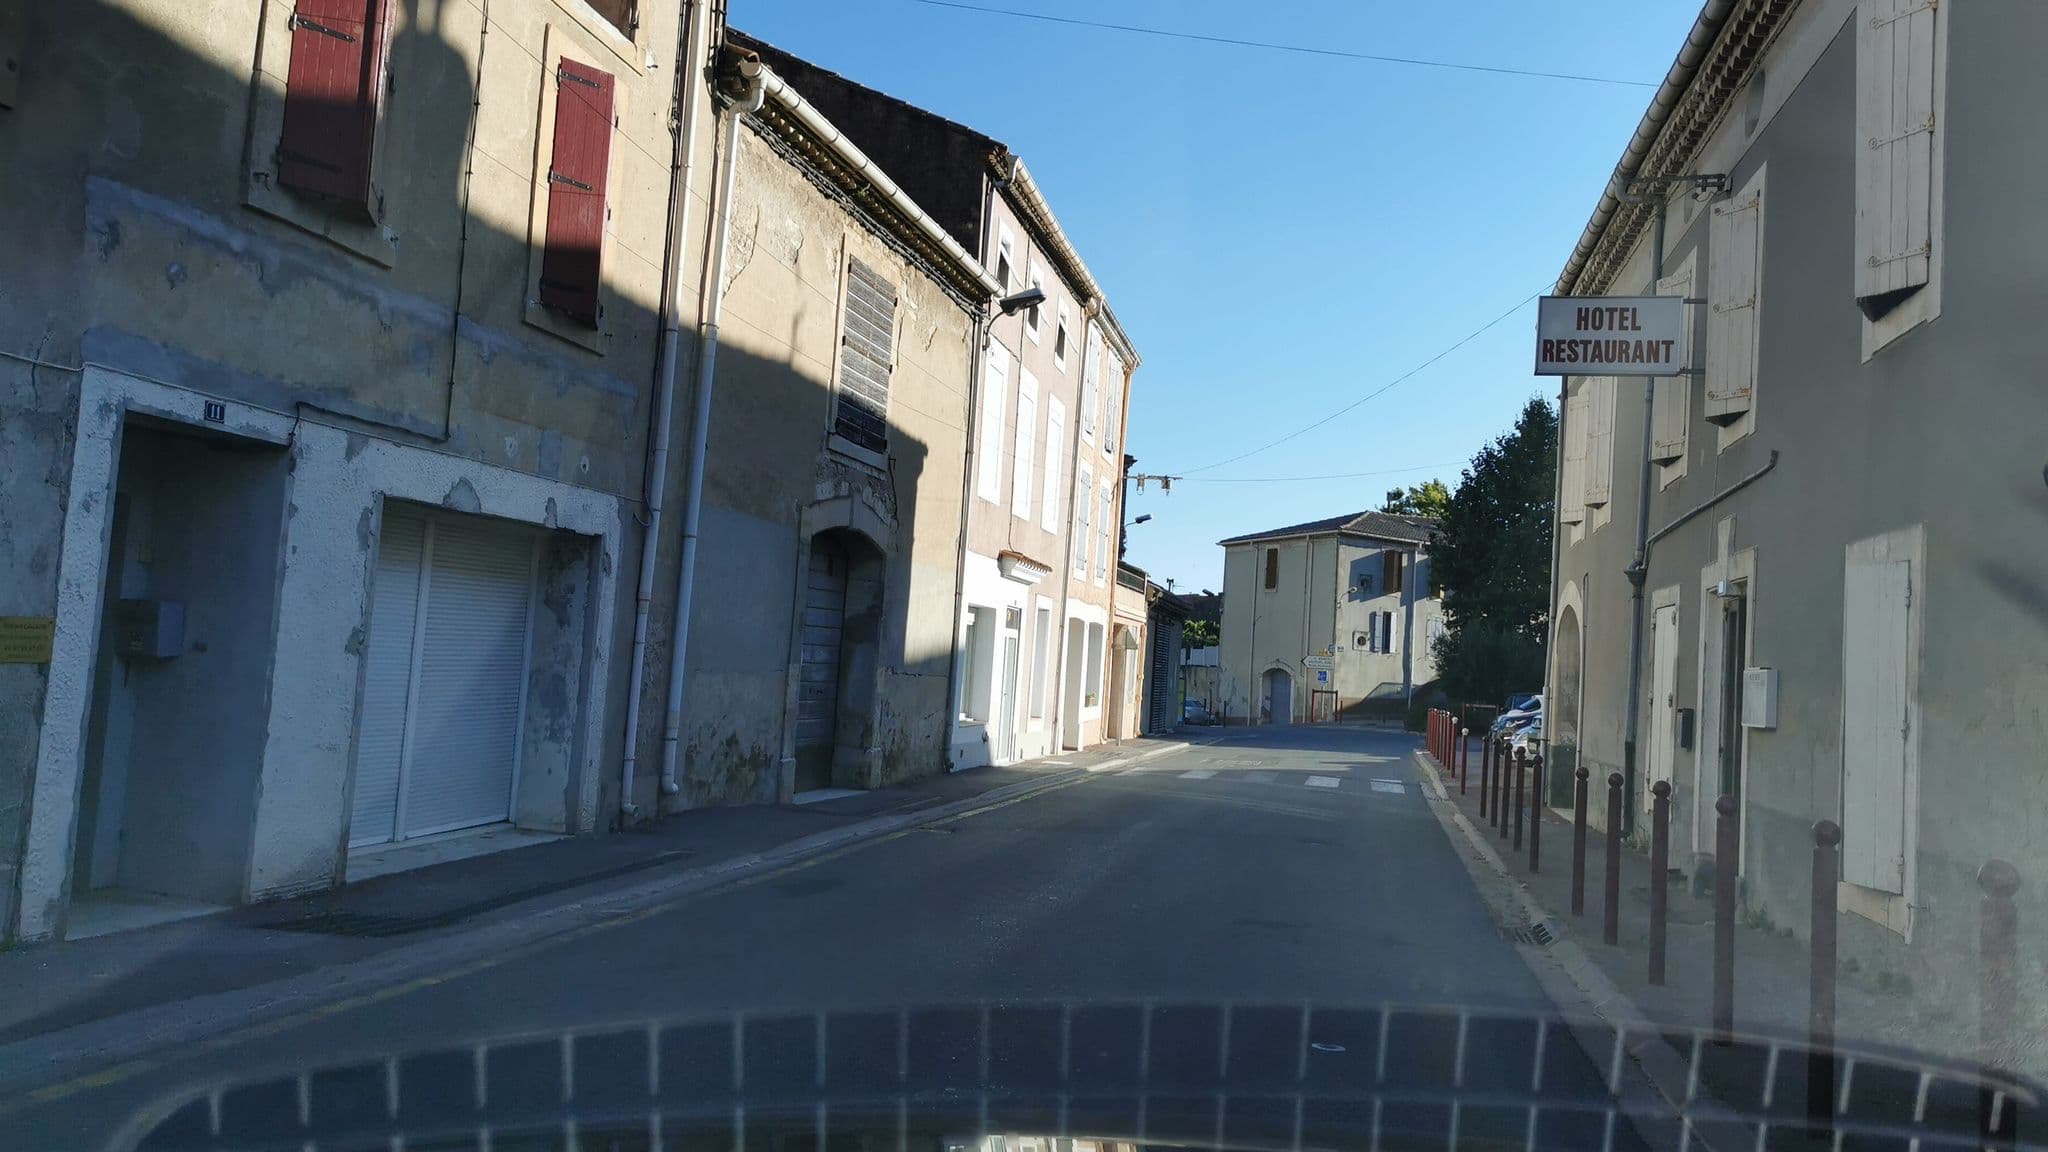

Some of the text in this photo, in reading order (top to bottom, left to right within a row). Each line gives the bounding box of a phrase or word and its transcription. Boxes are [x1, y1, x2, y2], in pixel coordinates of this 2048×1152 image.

[1576, 307, 1642, 331] HOTEL
[1542, 339, 1675, 364] RESTAURANT
[210, 405, 220, 419] 11
